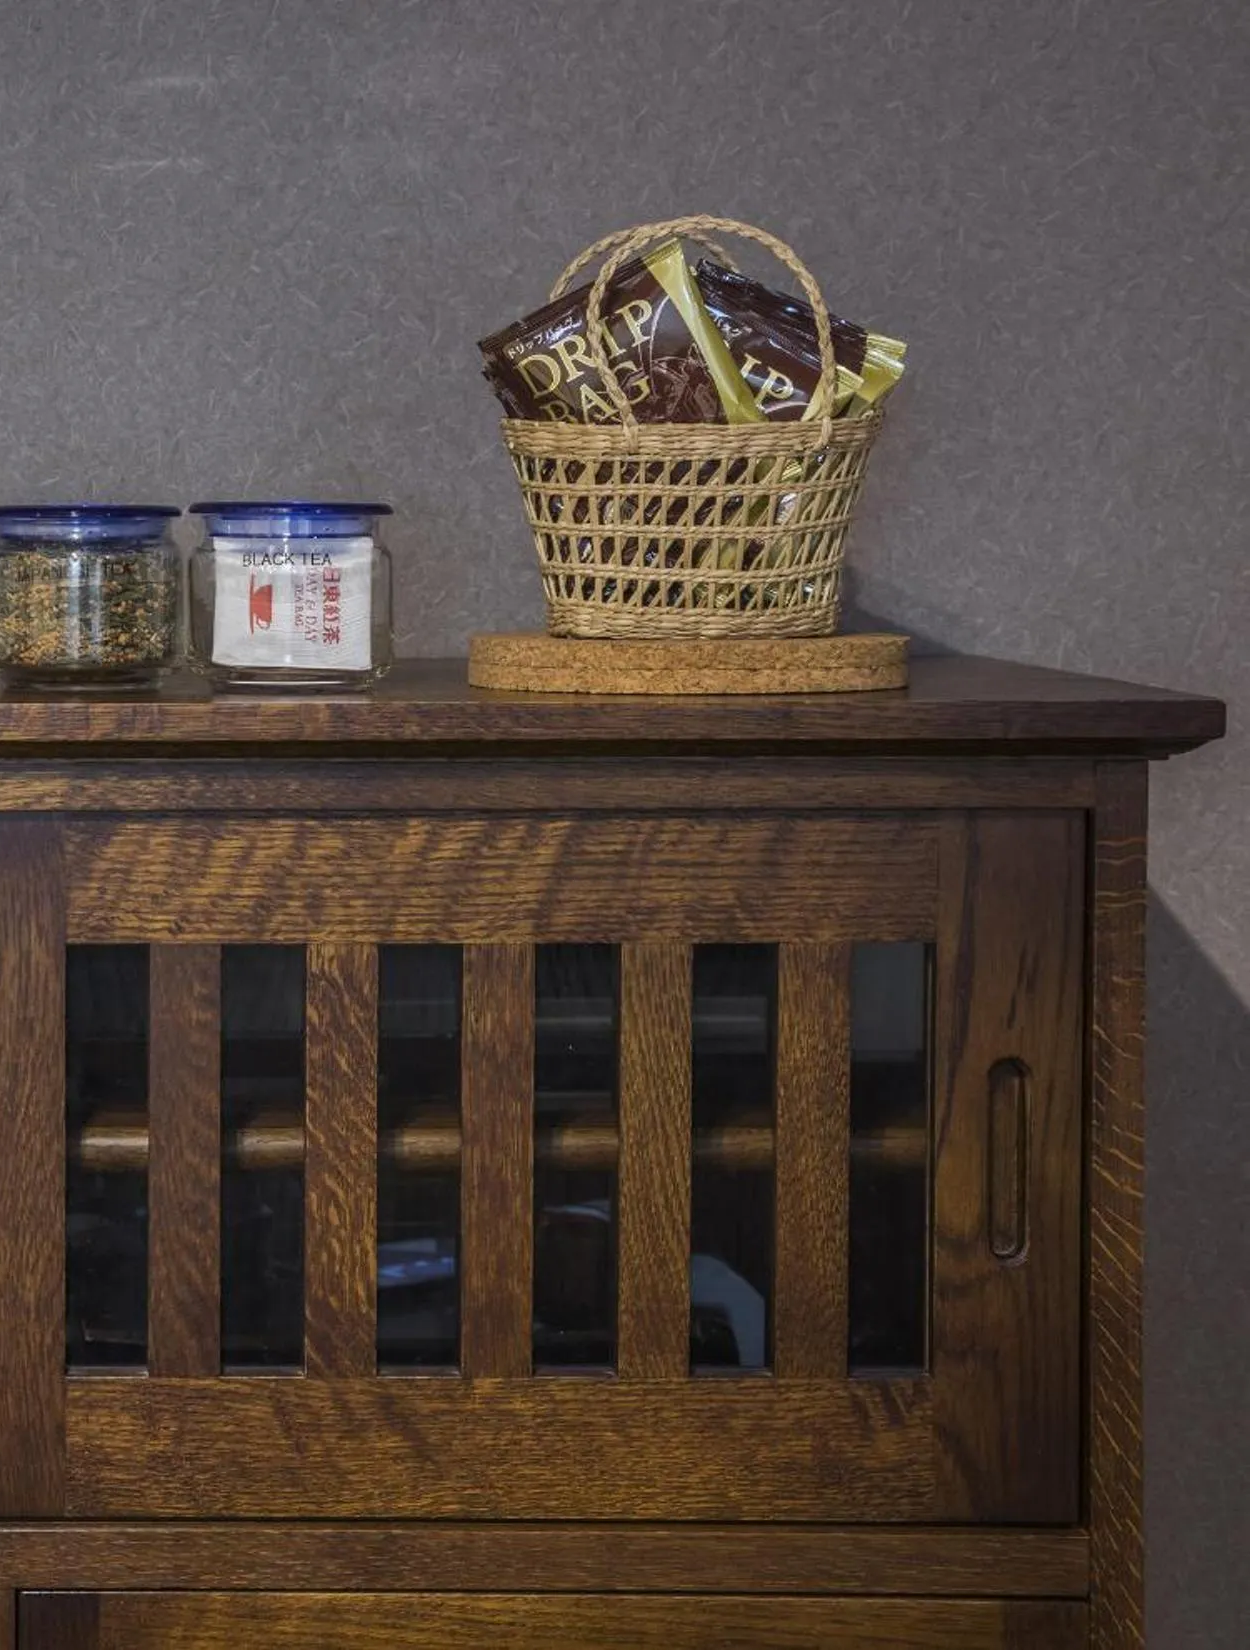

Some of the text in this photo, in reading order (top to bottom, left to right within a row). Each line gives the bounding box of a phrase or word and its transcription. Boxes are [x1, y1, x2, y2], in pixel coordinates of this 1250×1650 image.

[514, 300, 652, 399] DRIP
[243, 552, 332, 567] BLACK TEA
[294, 584, 304, 627] TEA BAG
[323, 567, 341, 645] 日東紅茶
[305, 616, 318, 642] DAY
